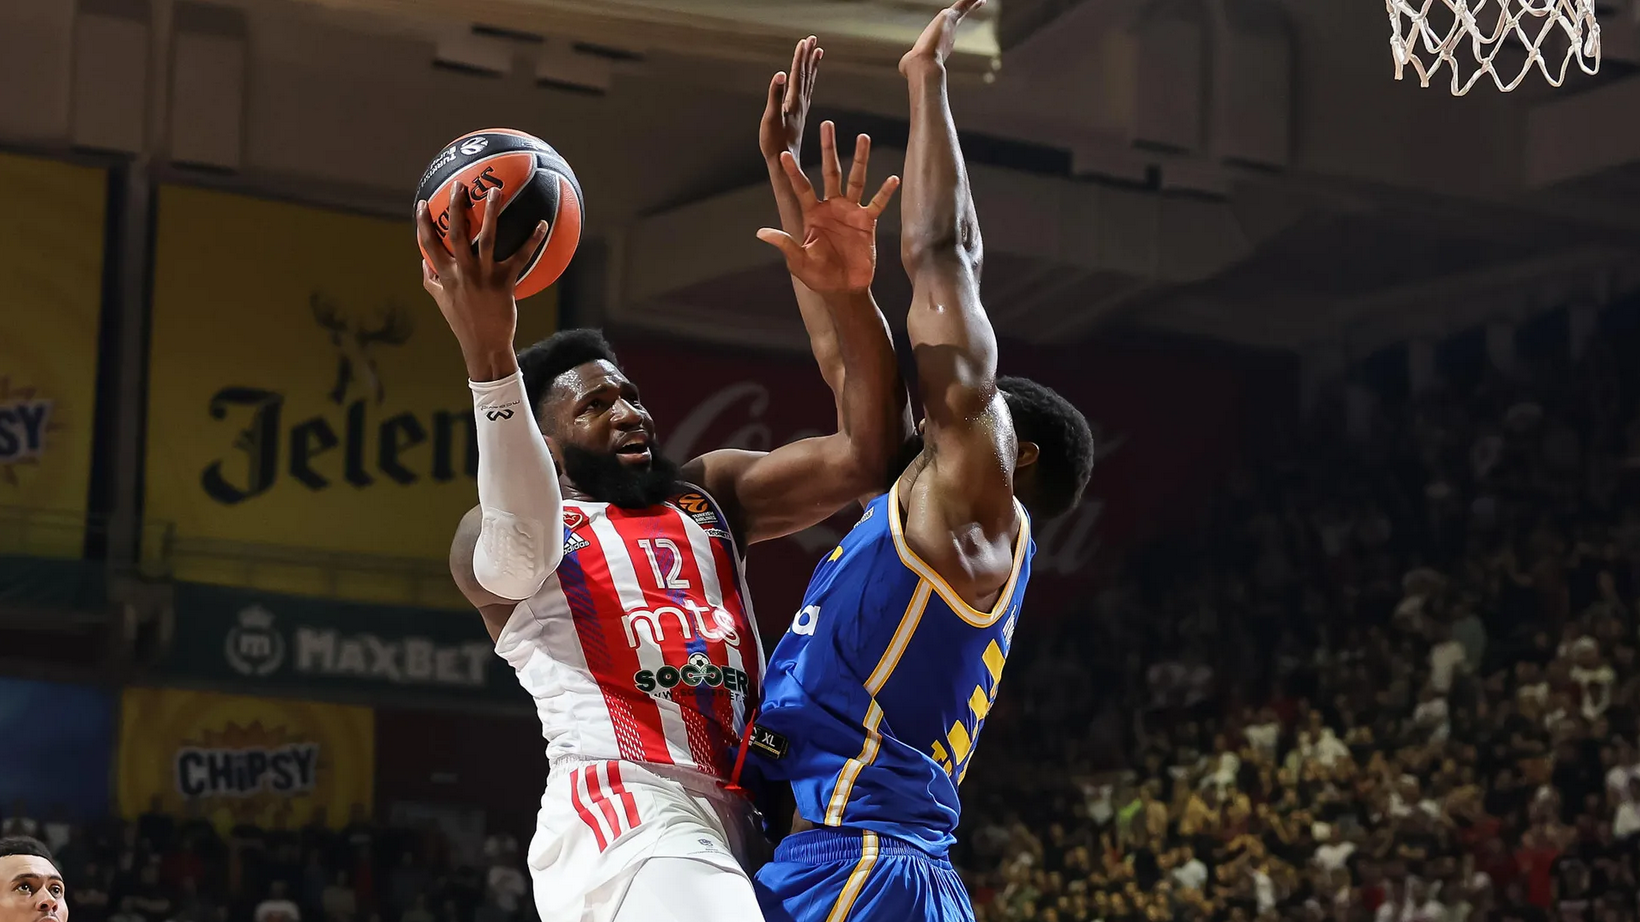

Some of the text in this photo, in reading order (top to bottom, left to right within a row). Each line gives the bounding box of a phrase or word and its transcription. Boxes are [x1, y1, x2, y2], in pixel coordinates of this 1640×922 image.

[201, 387, 477, 505] Jelen
[637, 539, 691, 589] 12
[621, 599, 740, 648] mts
[633, 664, 749, 695] SOCCER
[762, 731, 776, 748] XL
